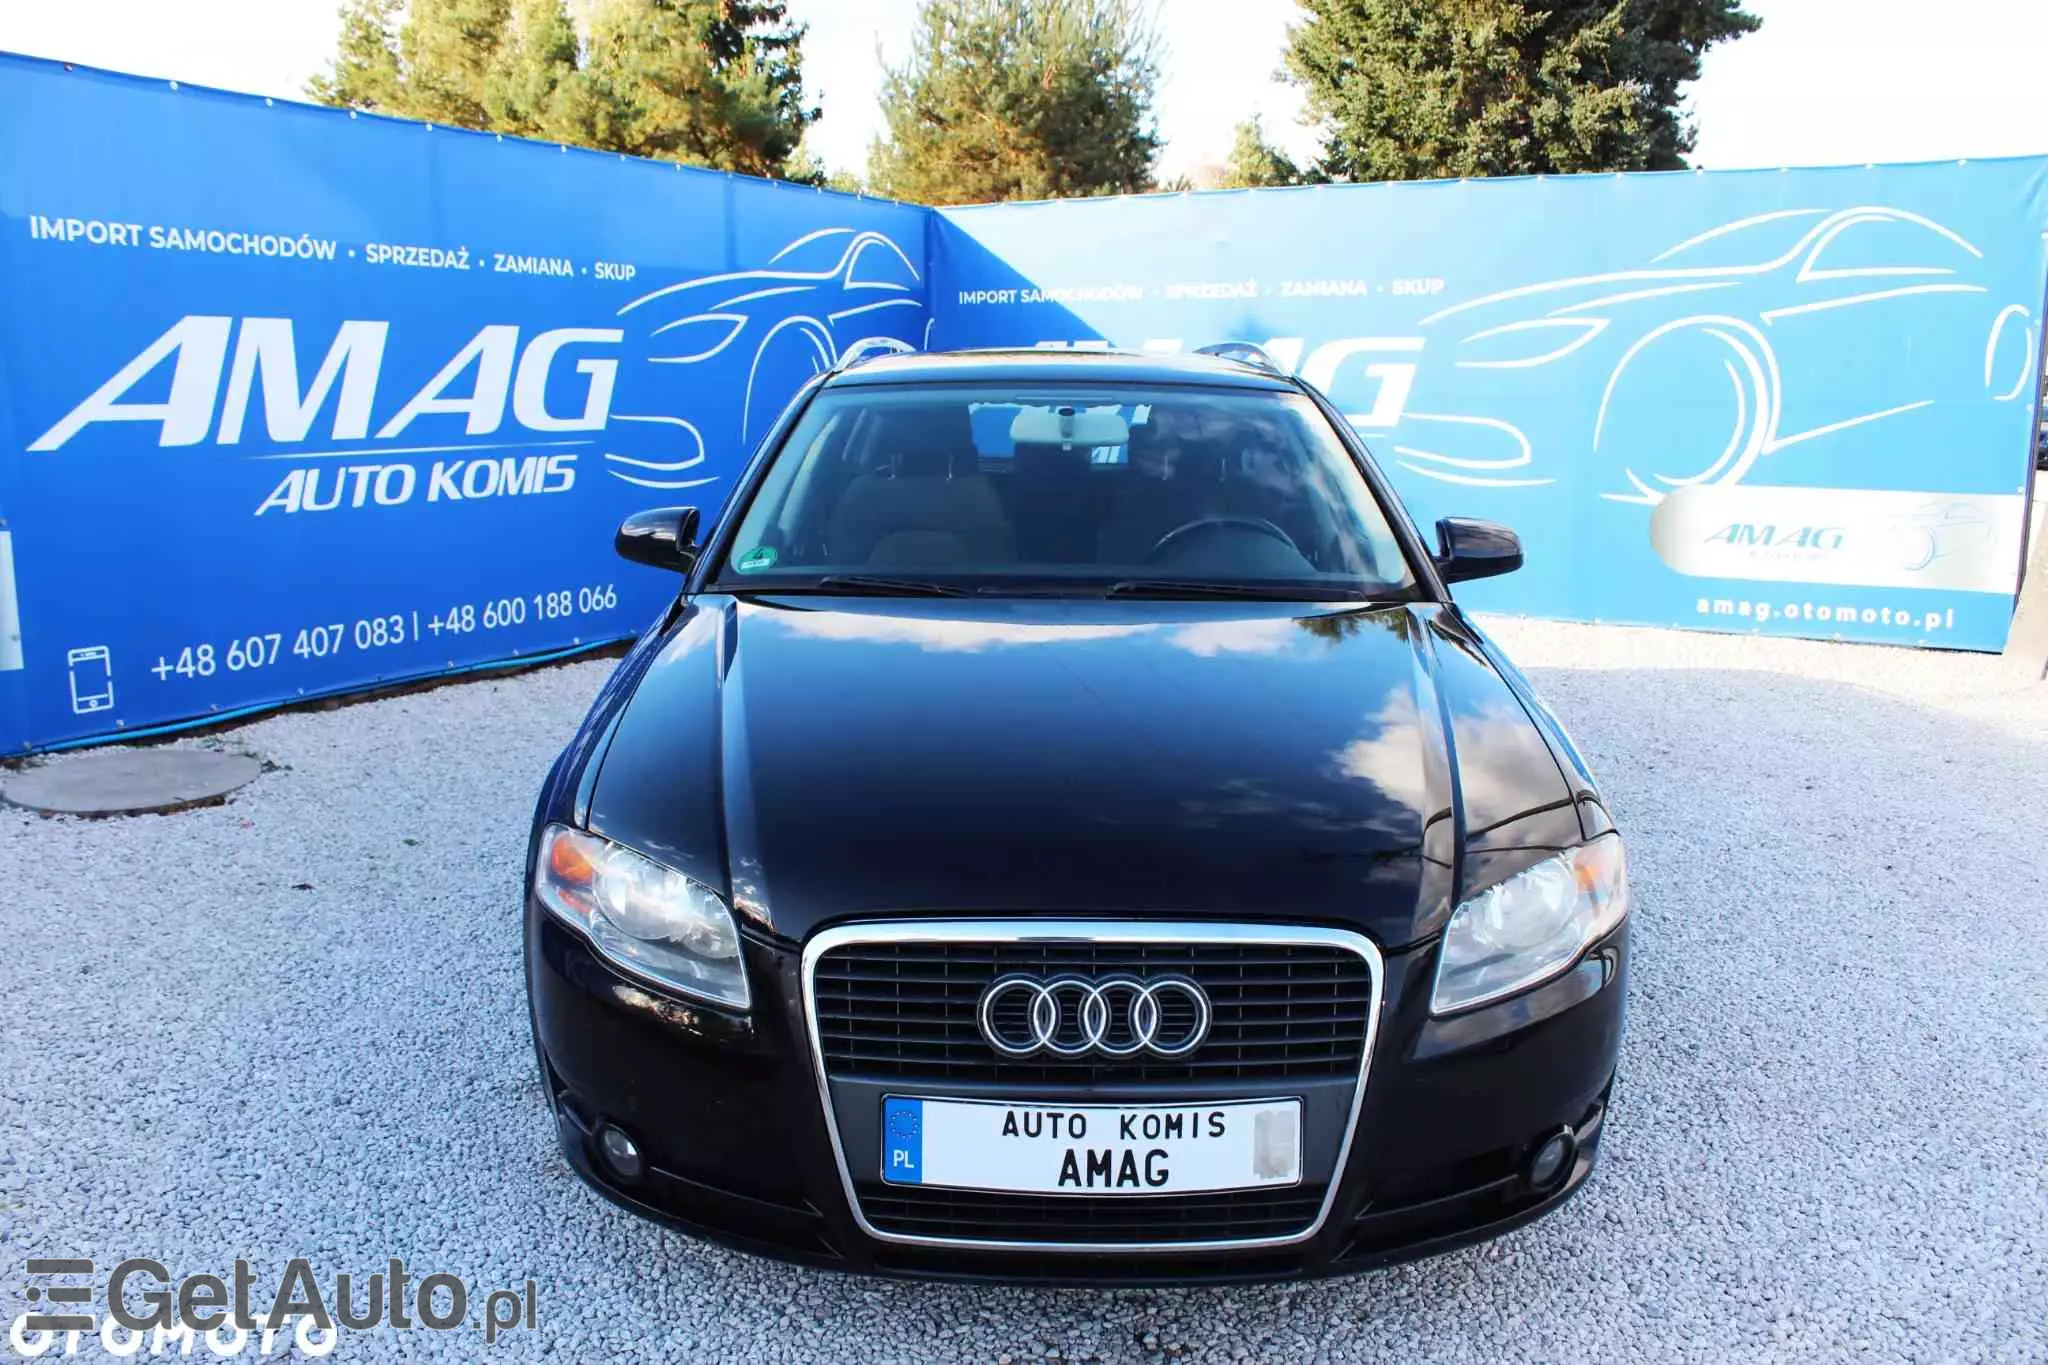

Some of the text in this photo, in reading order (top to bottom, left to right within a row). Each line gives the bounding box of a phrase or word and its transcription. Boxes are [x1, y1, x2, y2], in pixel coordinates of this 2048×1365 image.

[29, 215, 636, 280] IMPORT SAMOCHODÓW SPRZEDAŻ ZAMIANA SKUP
[959, 289, 1017, 305] IMPORT
[1280, 279, 1368, 297] ZAMIANA
[1392, 277, 1446, 295] SKUP
[26, 315, 624, 452] AMAG
[254, 455, 578, 516] AUTO KOMIS
[1703, 522, 1847, 549] AMAG
[151, 584, 618, 681] +48 607 407 083 +48 600 188 066
[1697, 598, 1955, 632] amag.otomoto.pl
[1002, 1111, 1226, 1140] AUTO KOMIS
[893, 1149, 915, 1168] PL
[1058, 1149, 1170, 1187] AMAG
